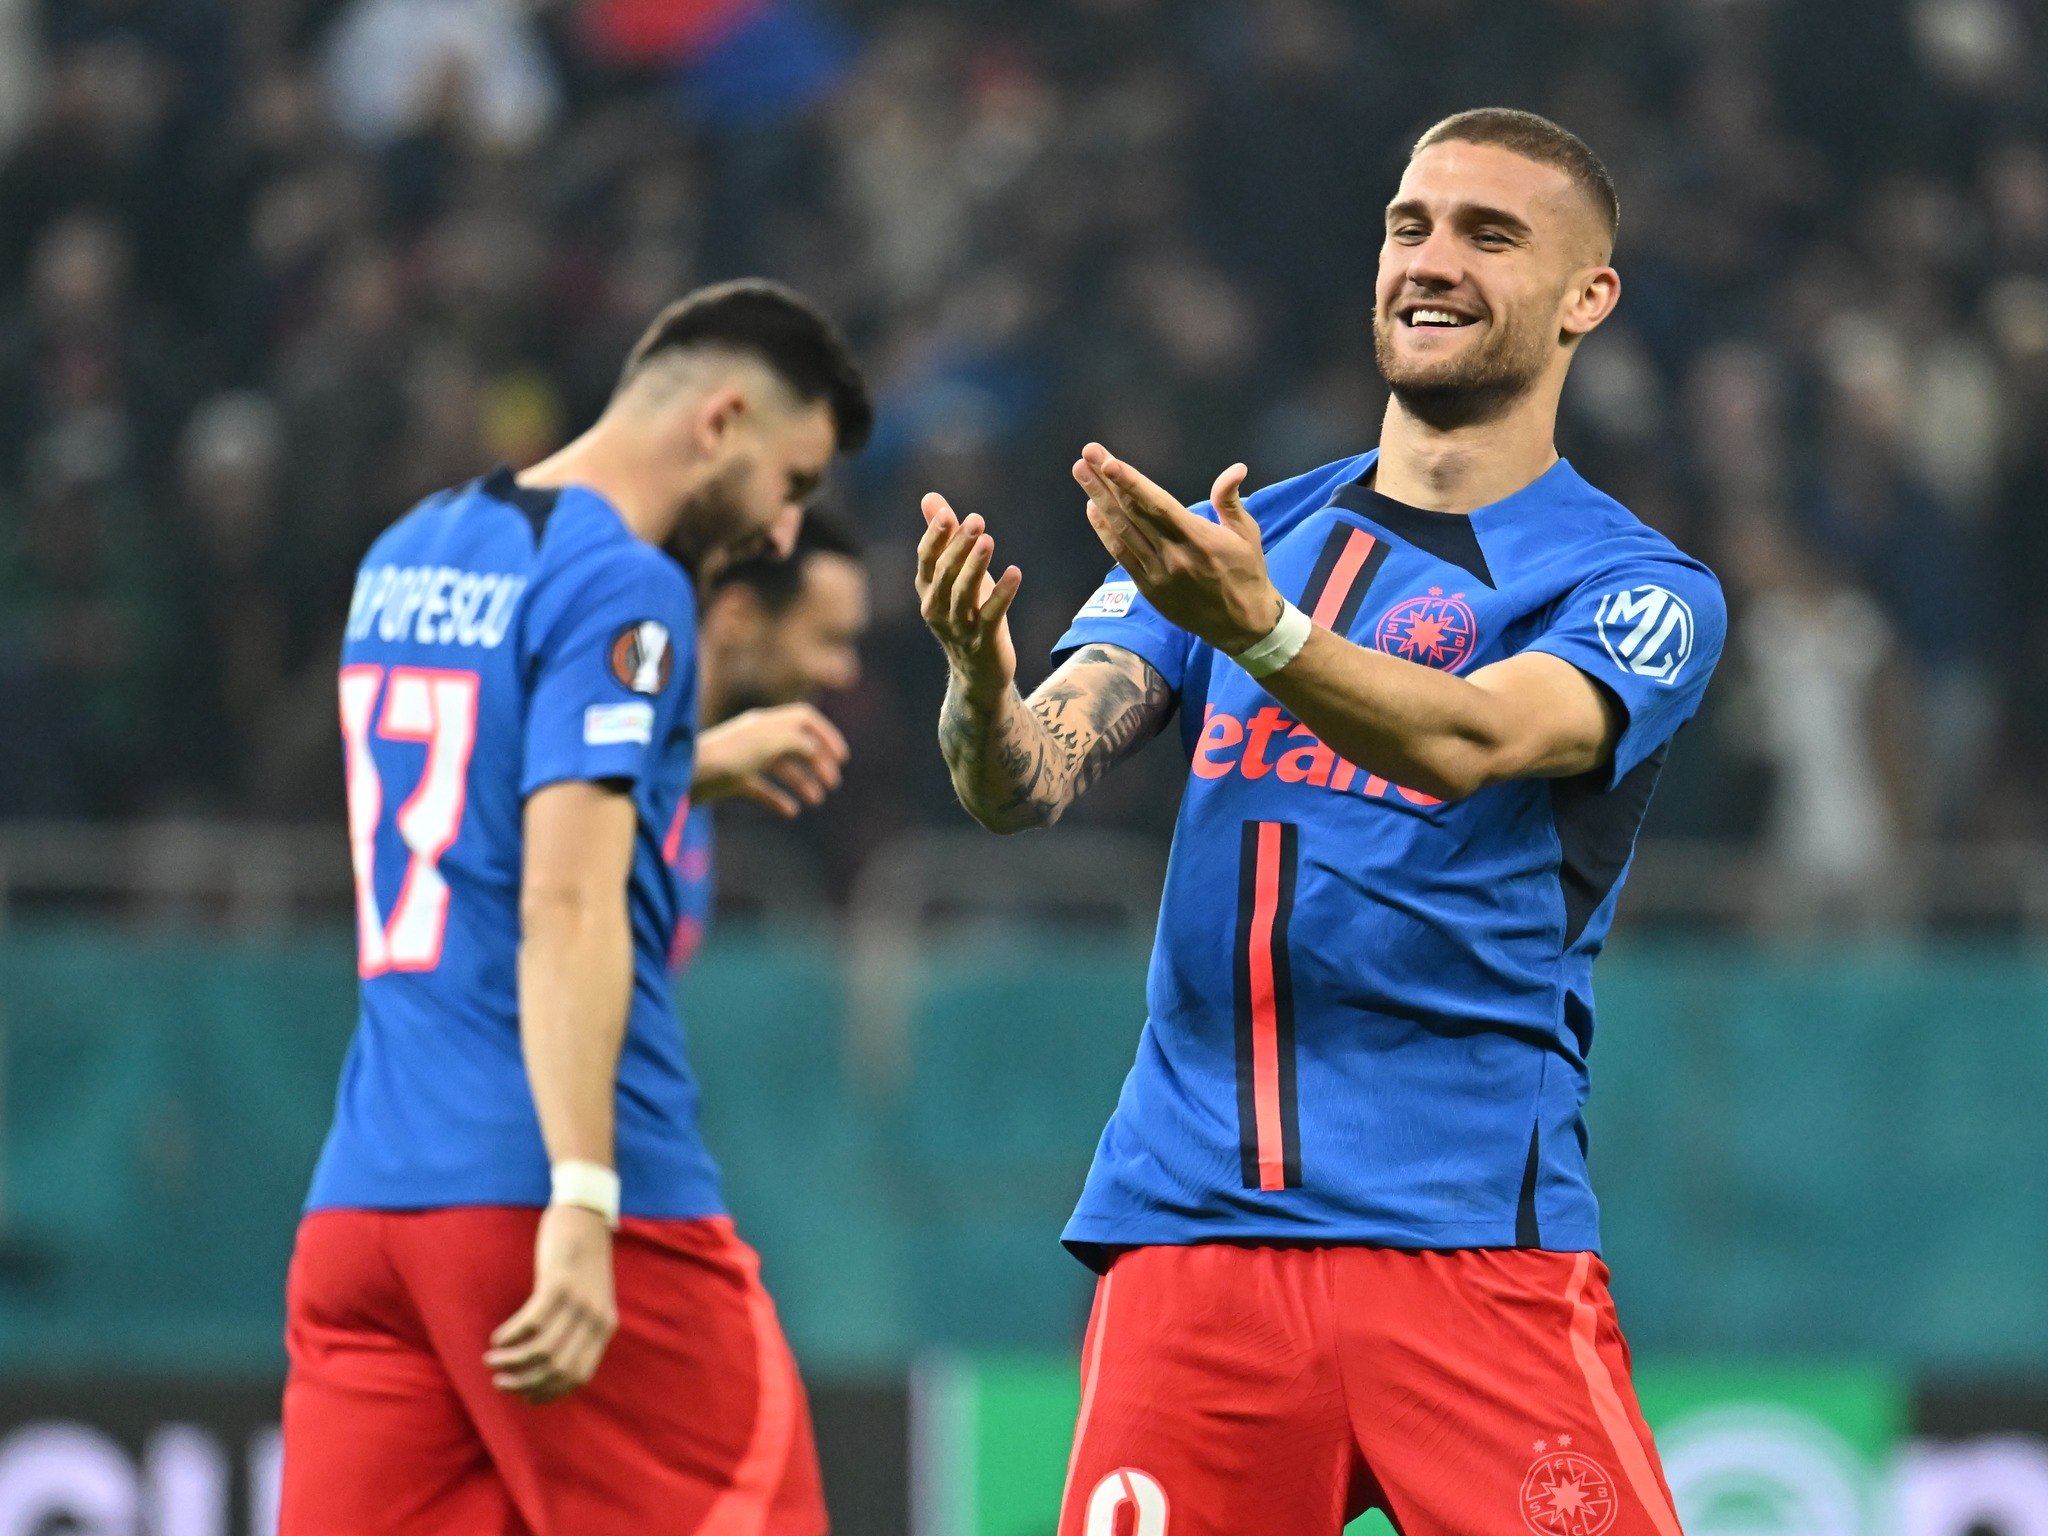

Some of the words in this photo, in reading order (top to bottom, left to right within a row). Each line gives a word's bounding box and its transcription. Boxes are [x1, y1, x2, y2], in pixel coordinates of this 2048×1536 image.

[1605, 589, 1688, 678] MG
[1191, 703, 1443, 806] eta
[339, 664, 480, 979] 17
